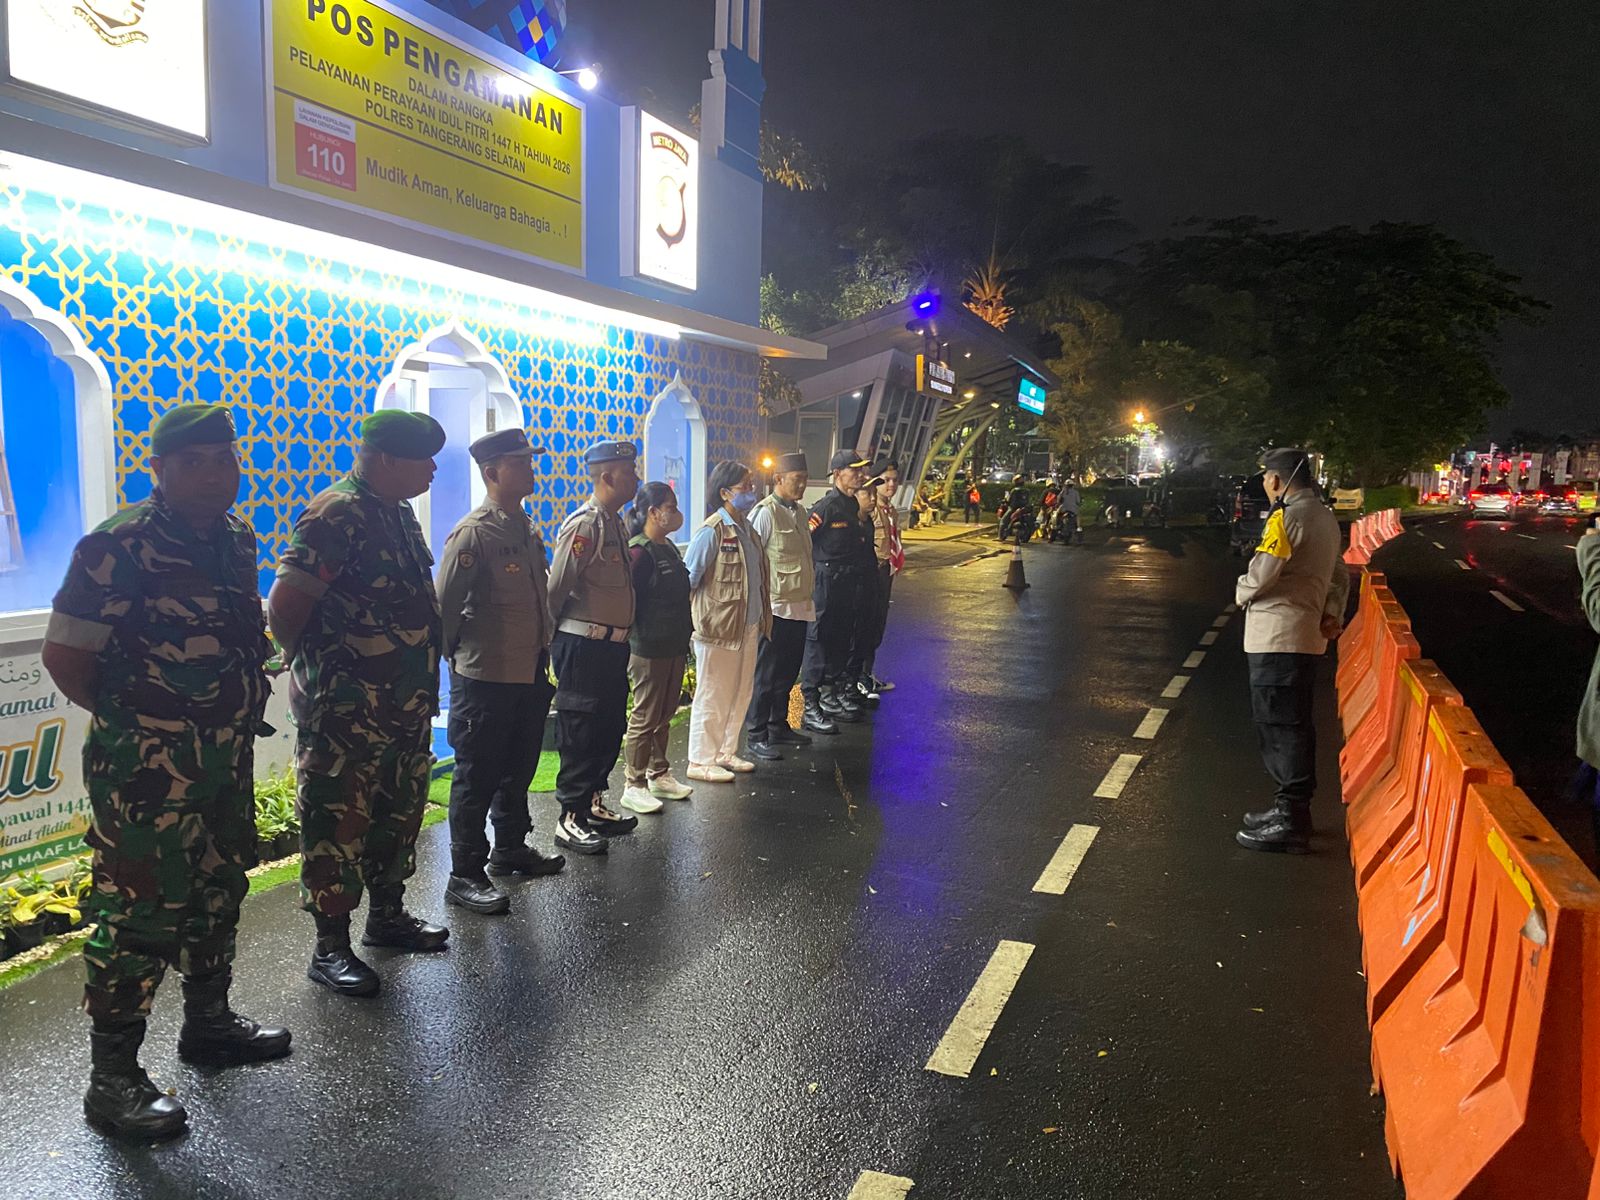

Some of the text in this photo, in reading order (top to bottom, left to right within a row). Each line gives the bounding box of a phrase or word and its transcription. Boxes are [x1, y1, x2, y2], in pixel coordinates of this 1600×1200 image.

[308, 0, 562, 134] POS PENGAMANAN
[408, 77, 493, 126] DALAM RANGKA
[290, 46, 571, 174] PELAYANAN PERAYAAN IDUL FITRI 1447 H TAHUN 2026
[365, 98, 526, 173] POLRES TANGERANG SELATAN
[307, 143, 346, 176] 110
[366, 157, 408, 187] Mudik
[411, 173, 452, 204] Aman,
[456, 187, 507, 220] Keluarga
[509, 206, 550, 233] Bahagia
[18, 843, 64, 866] MAAF
